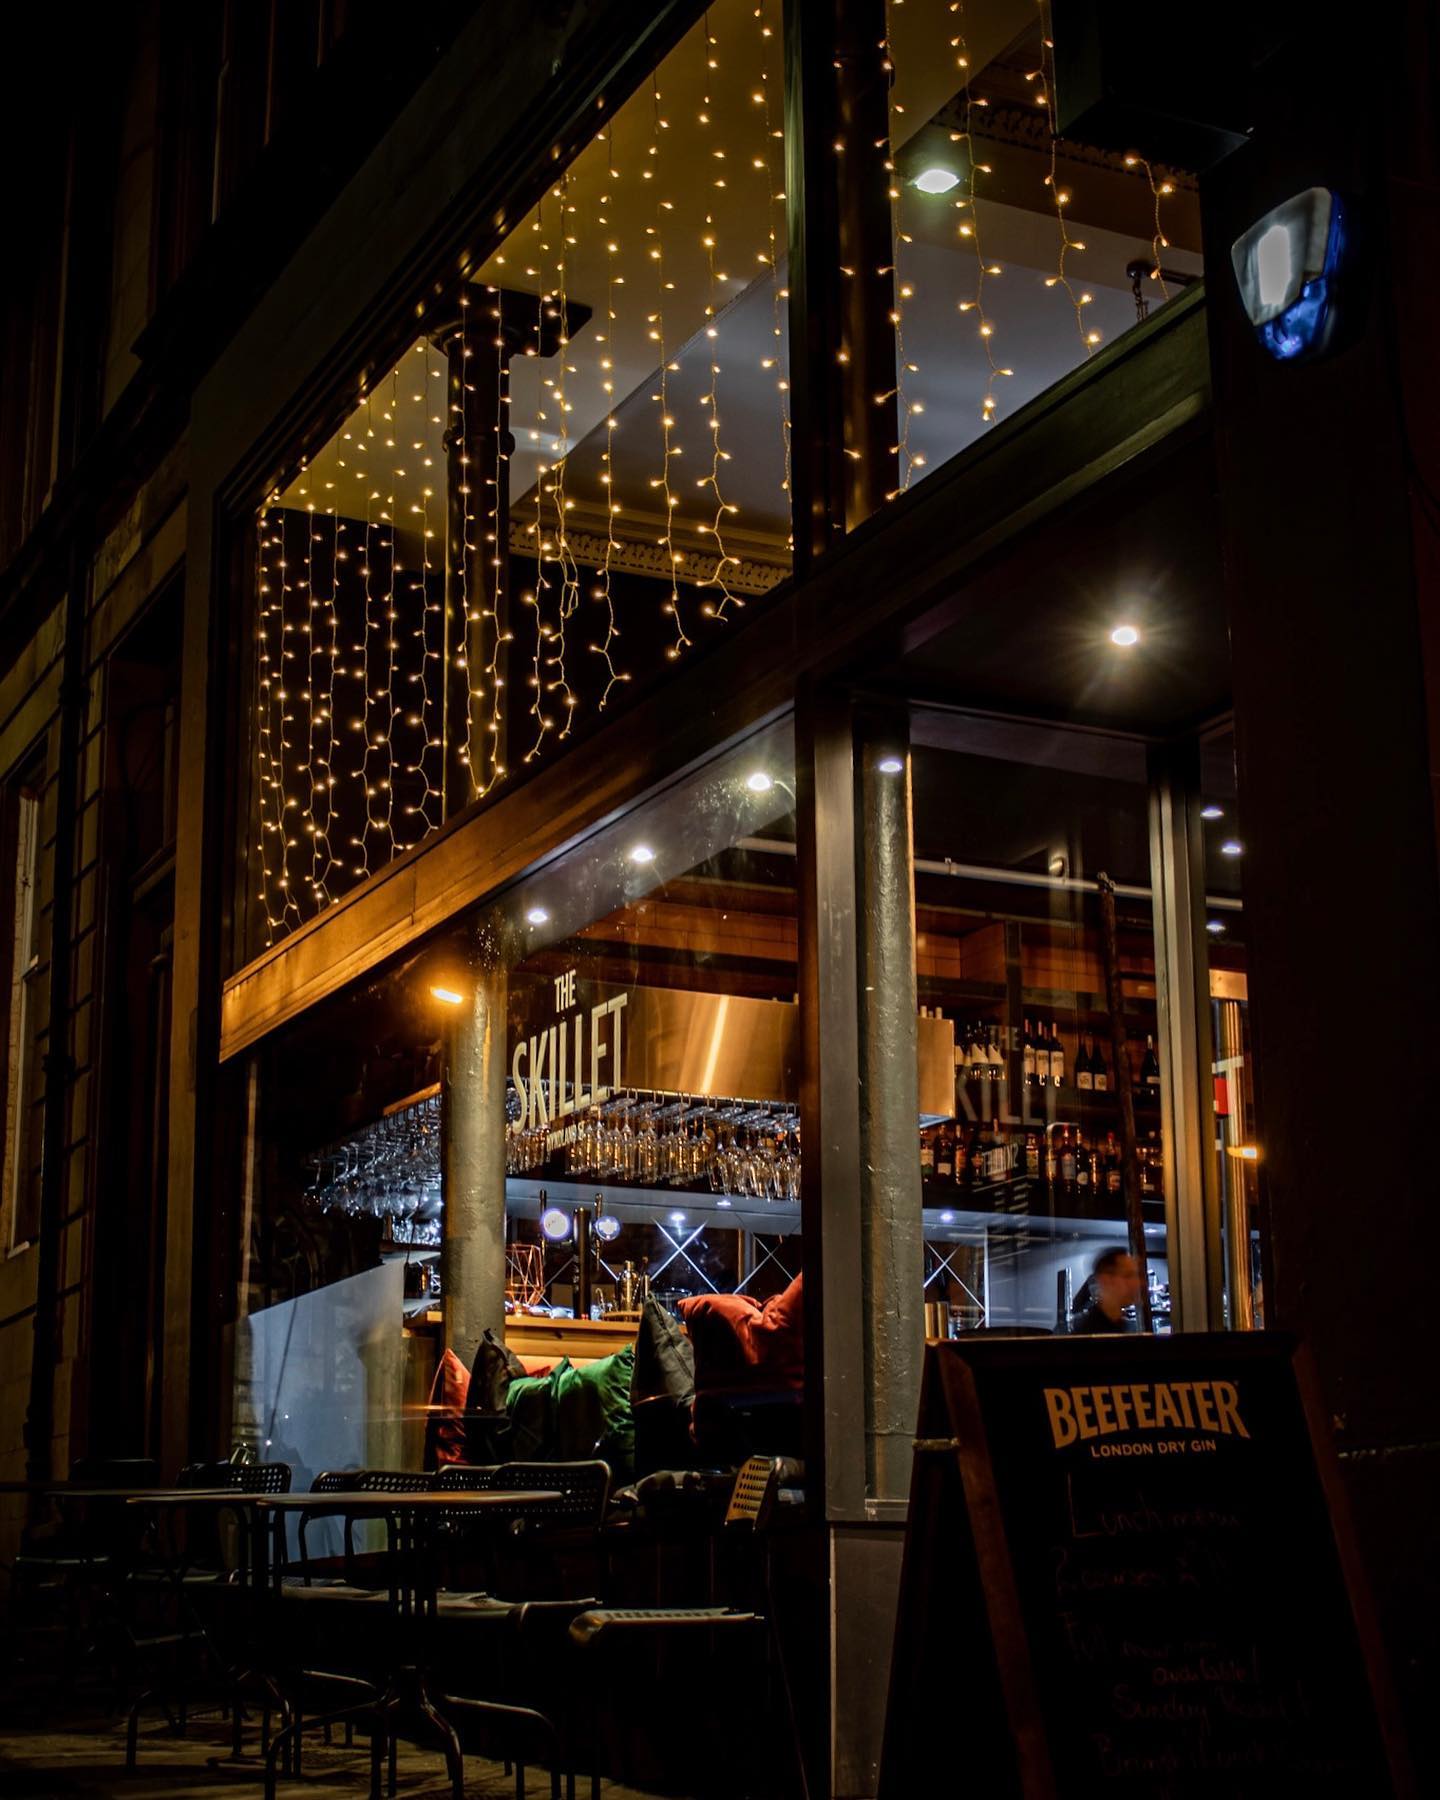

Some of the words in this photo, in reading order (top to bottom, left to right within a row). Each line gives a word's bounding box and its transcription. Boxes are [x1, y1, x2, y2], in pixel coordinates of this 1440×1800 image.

[554, 968, 577, 1013] THE
[512, 992, 628, 1135] SKILLET
[1043, 1380, 1251, 1450] BEEFEATER
[1089, 1442, 1154, 1459] LONDON
[1157, 1440, 1189, 1455] DRY
[1191, 1439, 1217, 1453] GIN
